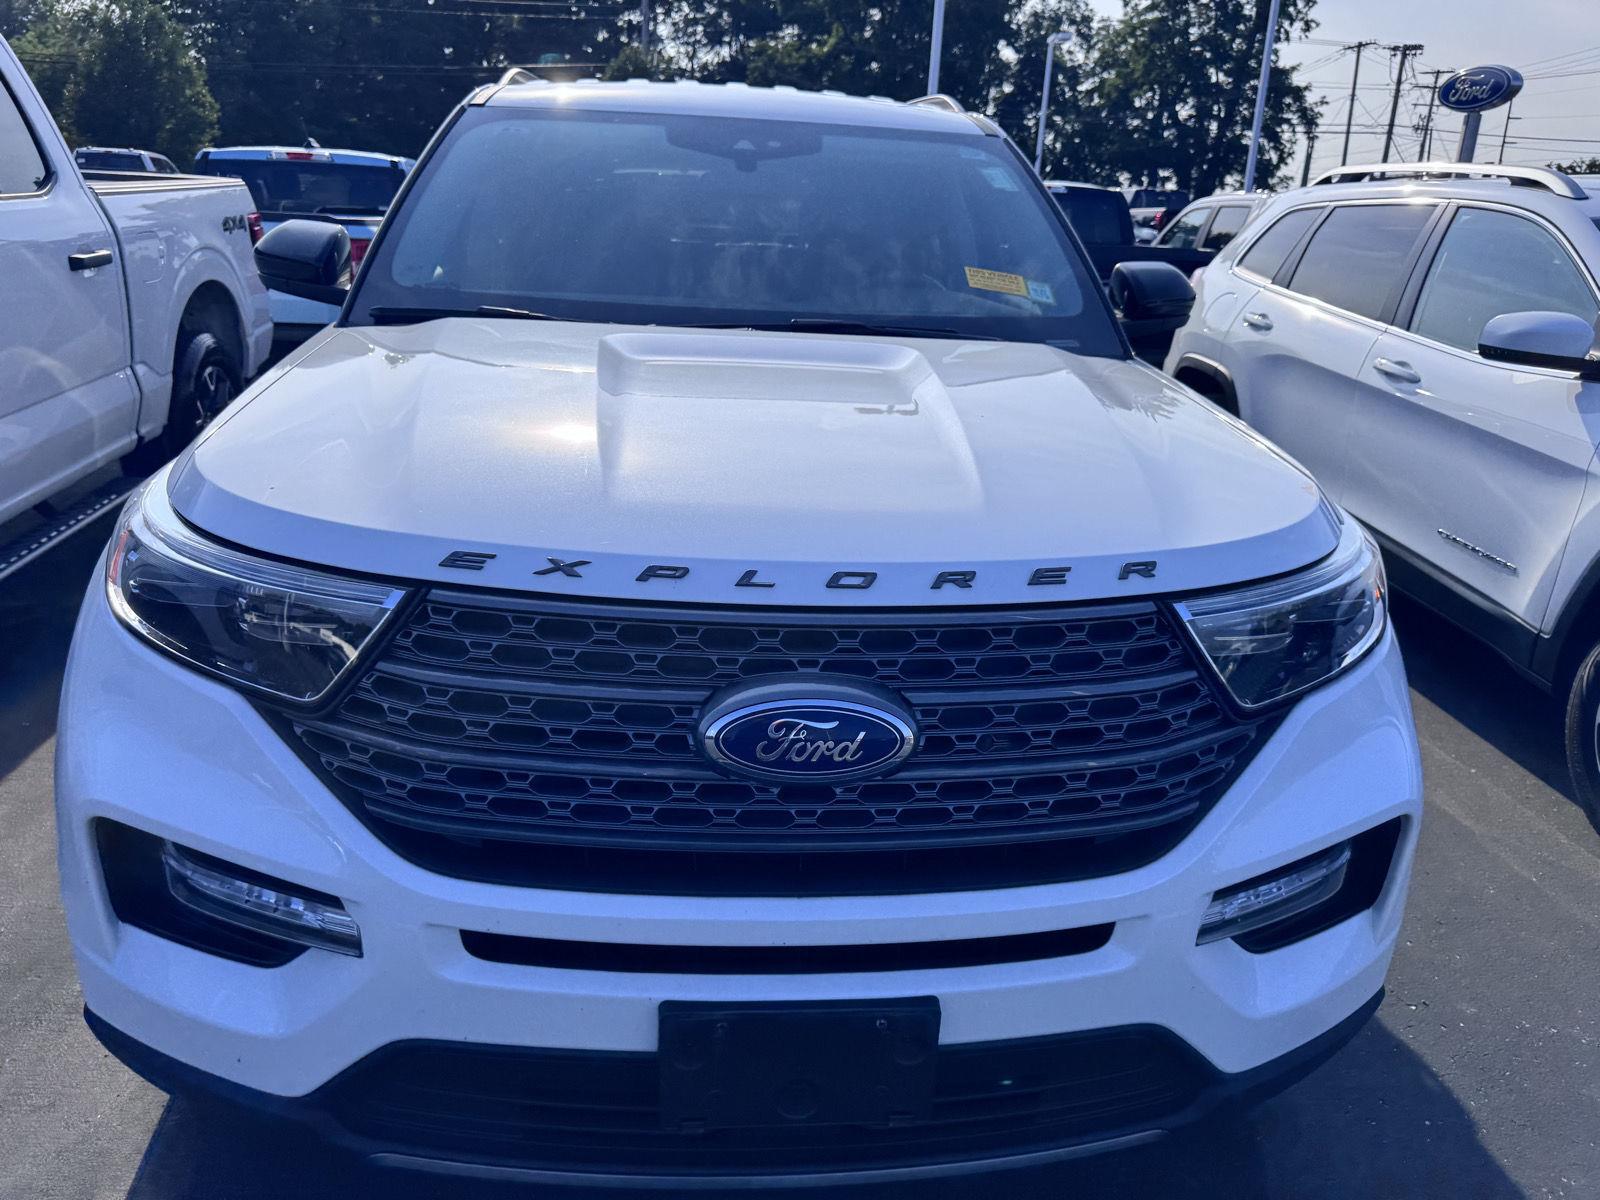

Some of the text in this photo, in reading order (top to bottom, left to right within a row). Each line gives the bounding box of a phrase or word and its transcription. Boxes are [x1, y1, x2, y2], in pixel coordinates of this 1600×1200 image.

[1448, 74, 1495, 103] Ford
[438, 550, 1158, 590] EXPLORER
[756, 718, 867, 762] Ford
